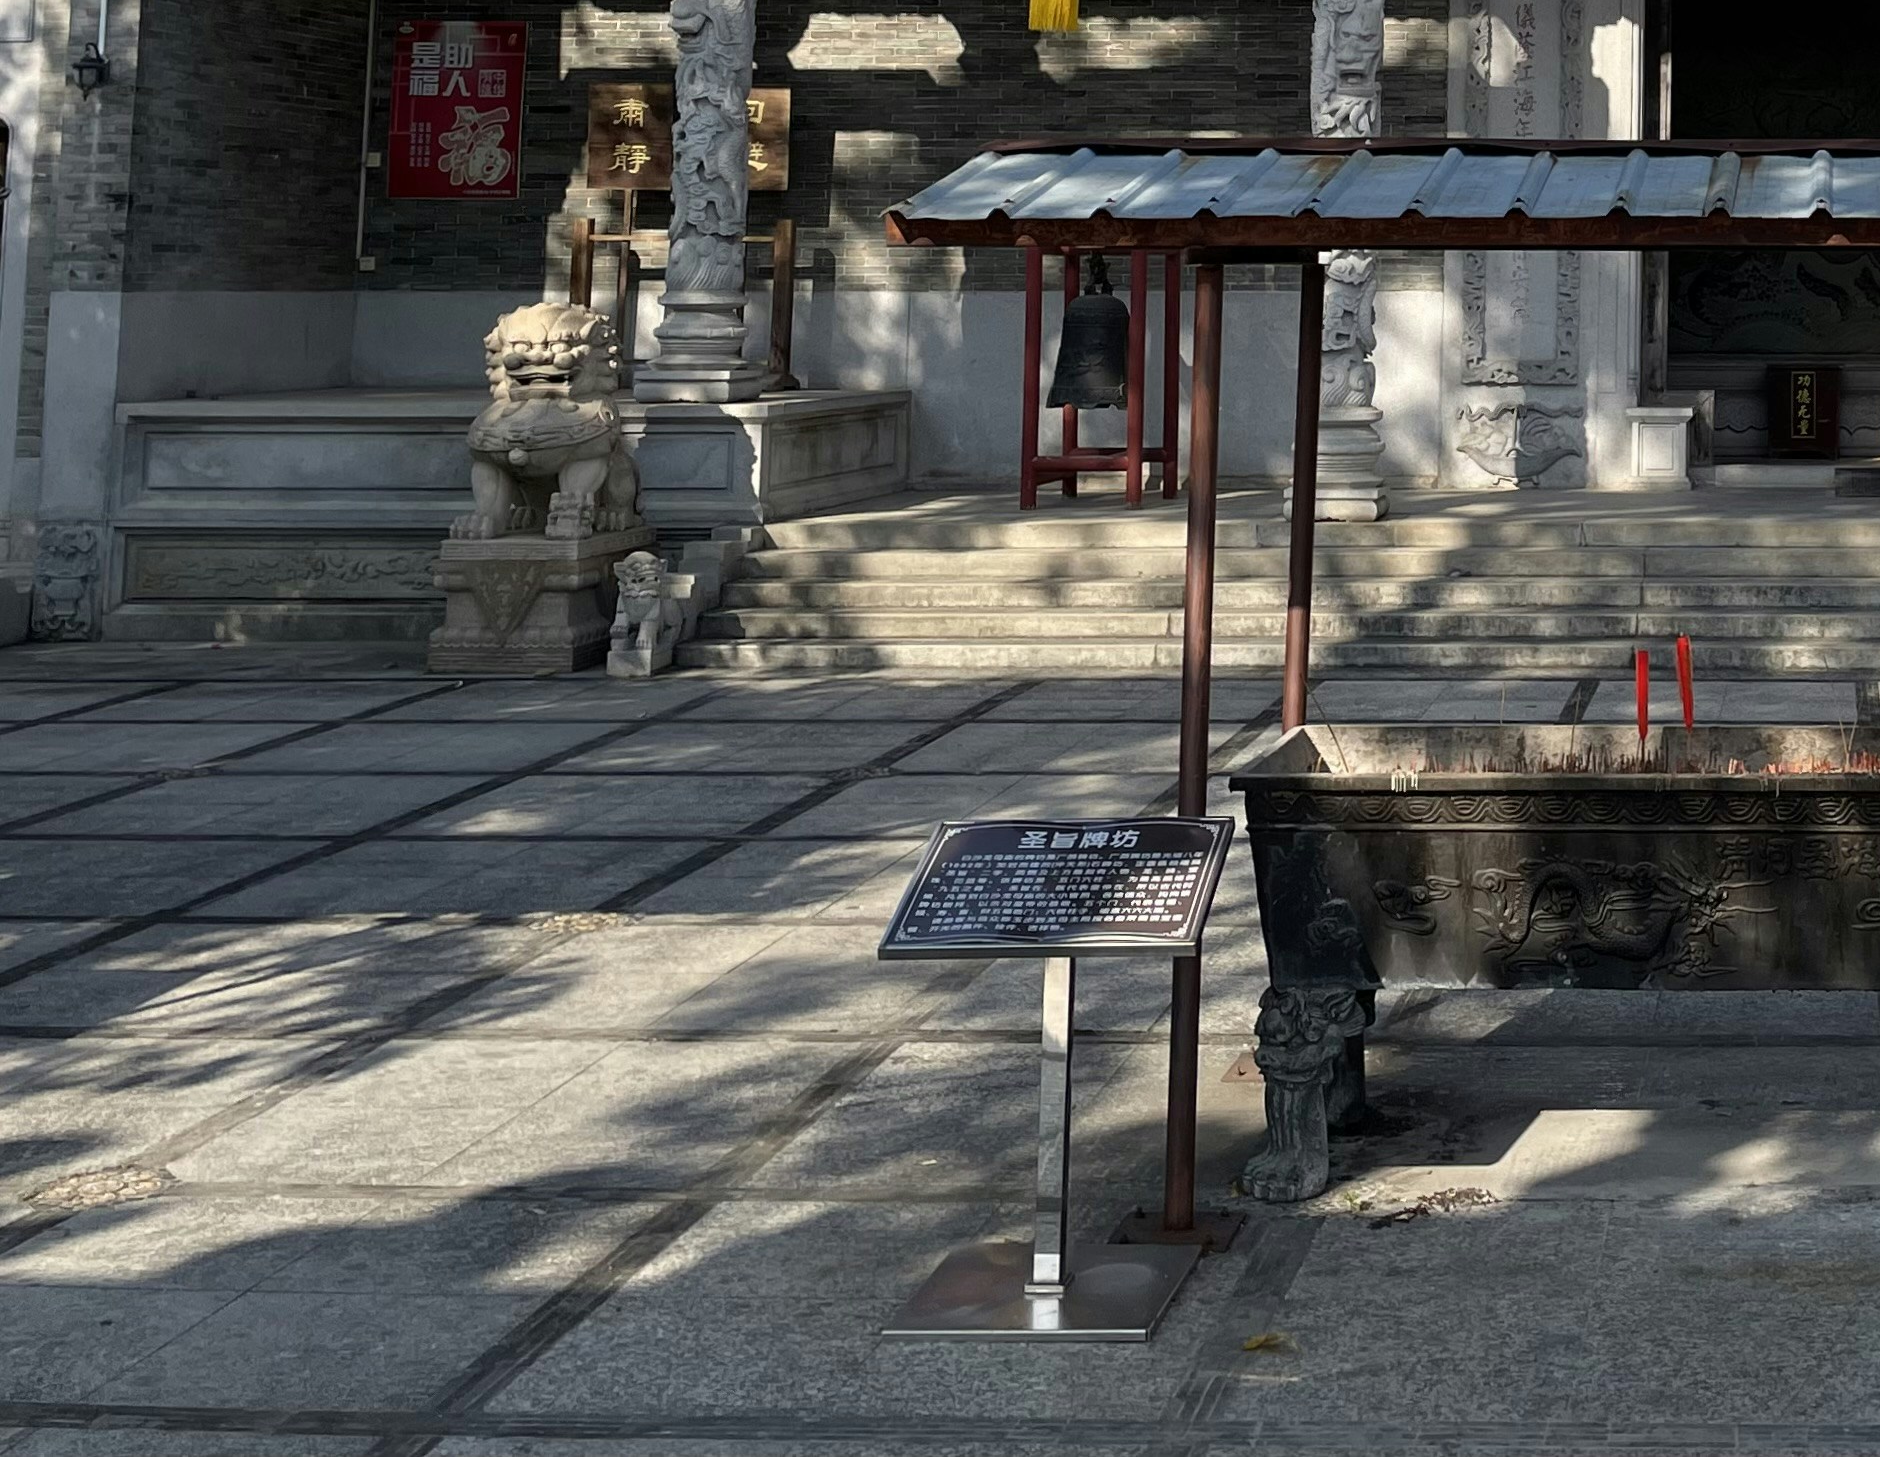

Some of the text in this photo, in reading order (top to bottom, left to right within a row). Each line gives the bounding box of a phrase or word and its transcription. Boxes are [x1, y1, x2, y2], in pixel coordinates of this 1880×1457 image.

[608, 98, 652, 174] 肅靜
[1795, 374, 1812, 436] 功德无量
[1017, 829, 1140, 851] 圣旨牌坊
